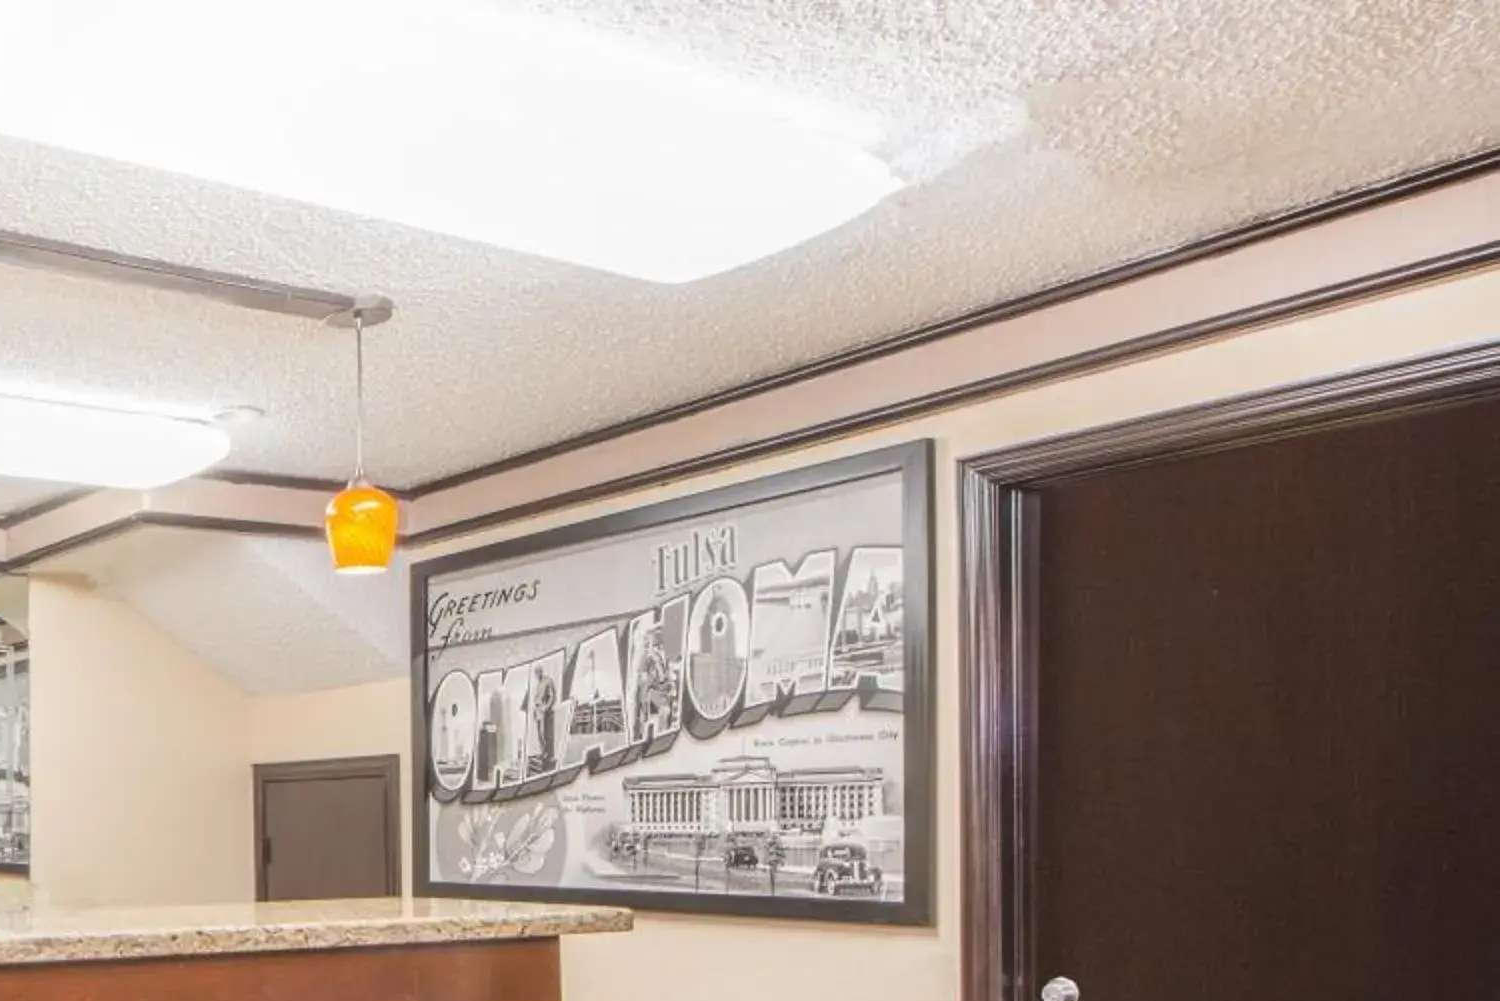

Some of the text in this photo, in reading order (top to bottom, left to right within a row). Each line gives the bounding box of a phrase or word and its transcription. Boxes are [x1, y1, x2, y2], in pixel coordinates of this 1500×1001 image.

[649, 522, 737, 592] Tulsa
[429, 579, 540, 637] GREETINGS
[431, 617, 493, 659] from
[429, 546, 903, 801] OKLAHOMA
